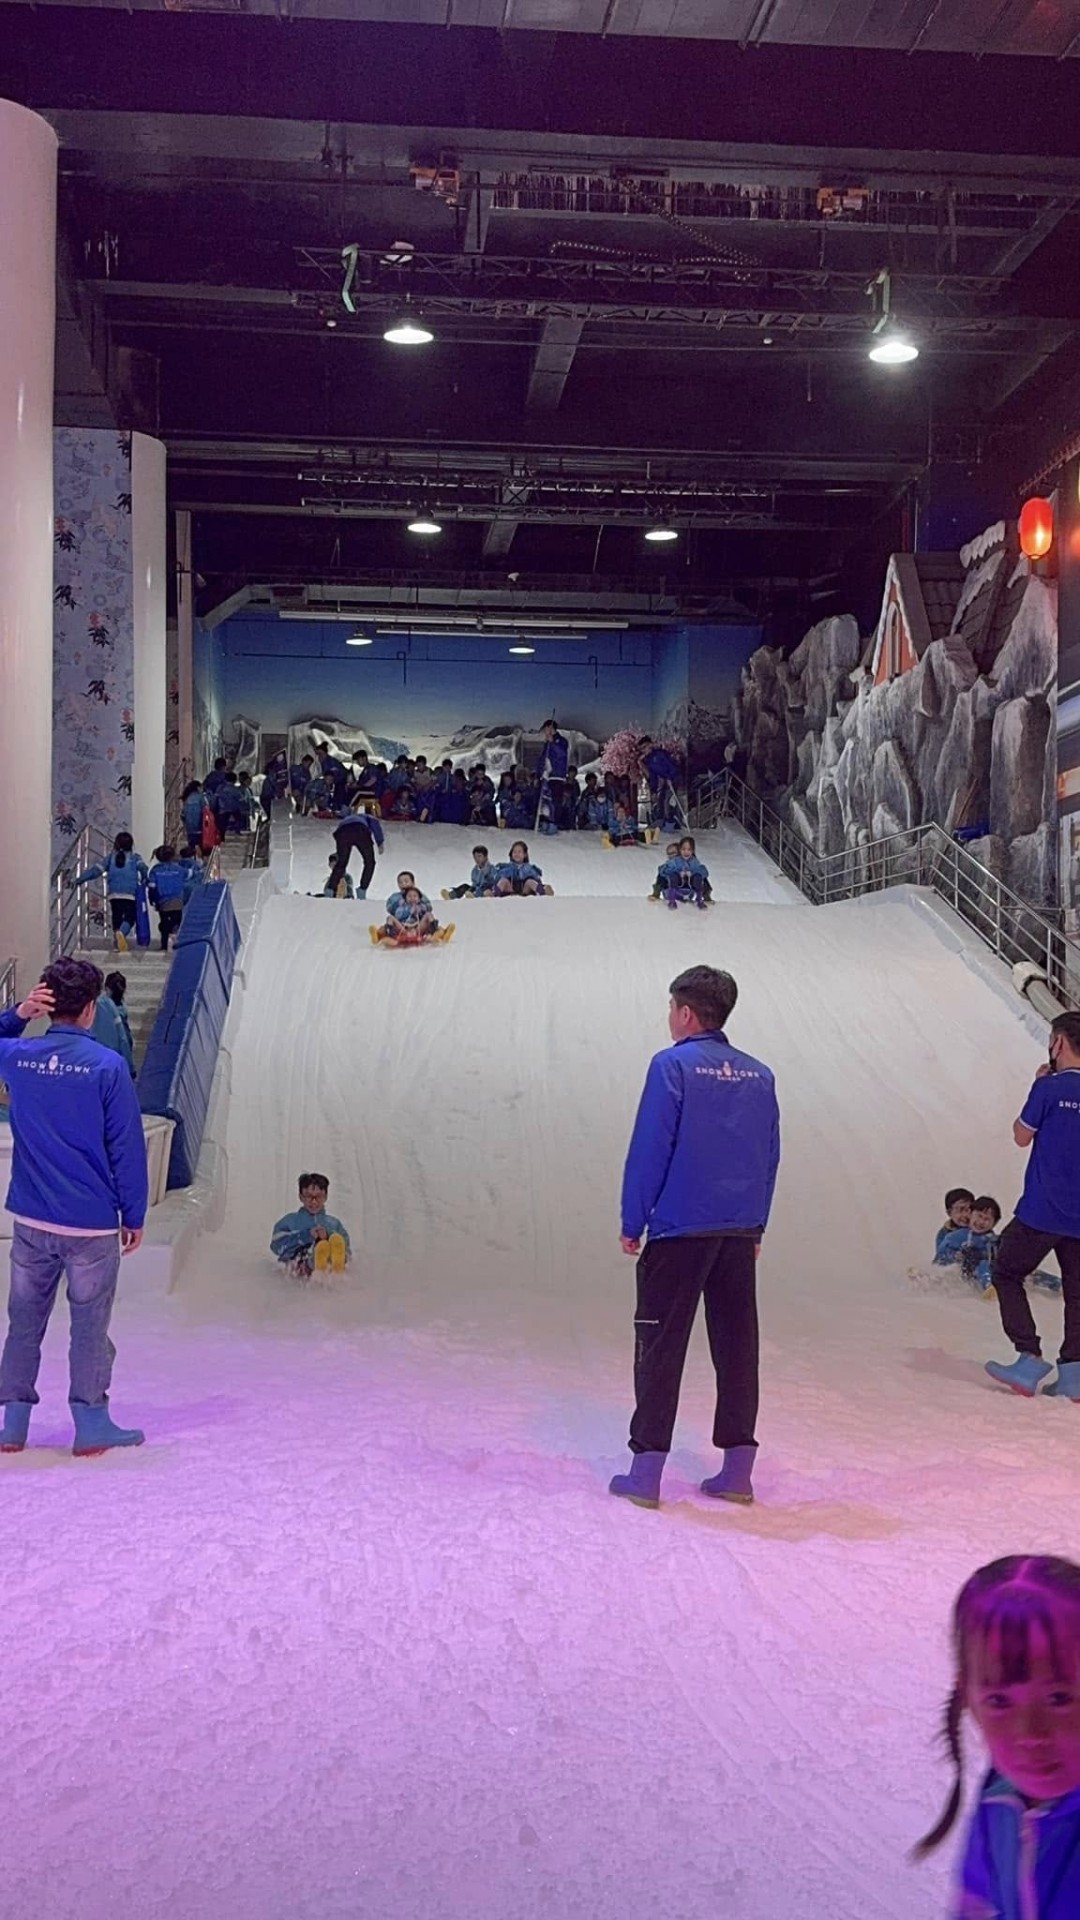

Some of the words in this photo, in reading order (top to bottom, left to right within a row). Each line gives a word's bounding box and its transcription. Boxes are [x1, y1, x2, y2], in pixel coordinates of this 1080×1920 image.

[17, 1060, 47, 1070] SNOW
[59, 1064, 91, 1074] TOWN
[695, 1066, 723, 1076] SNOW
[733, 1070, 760, 1078] TOWN
[1059, 1100, 1080, 1109] SNO
